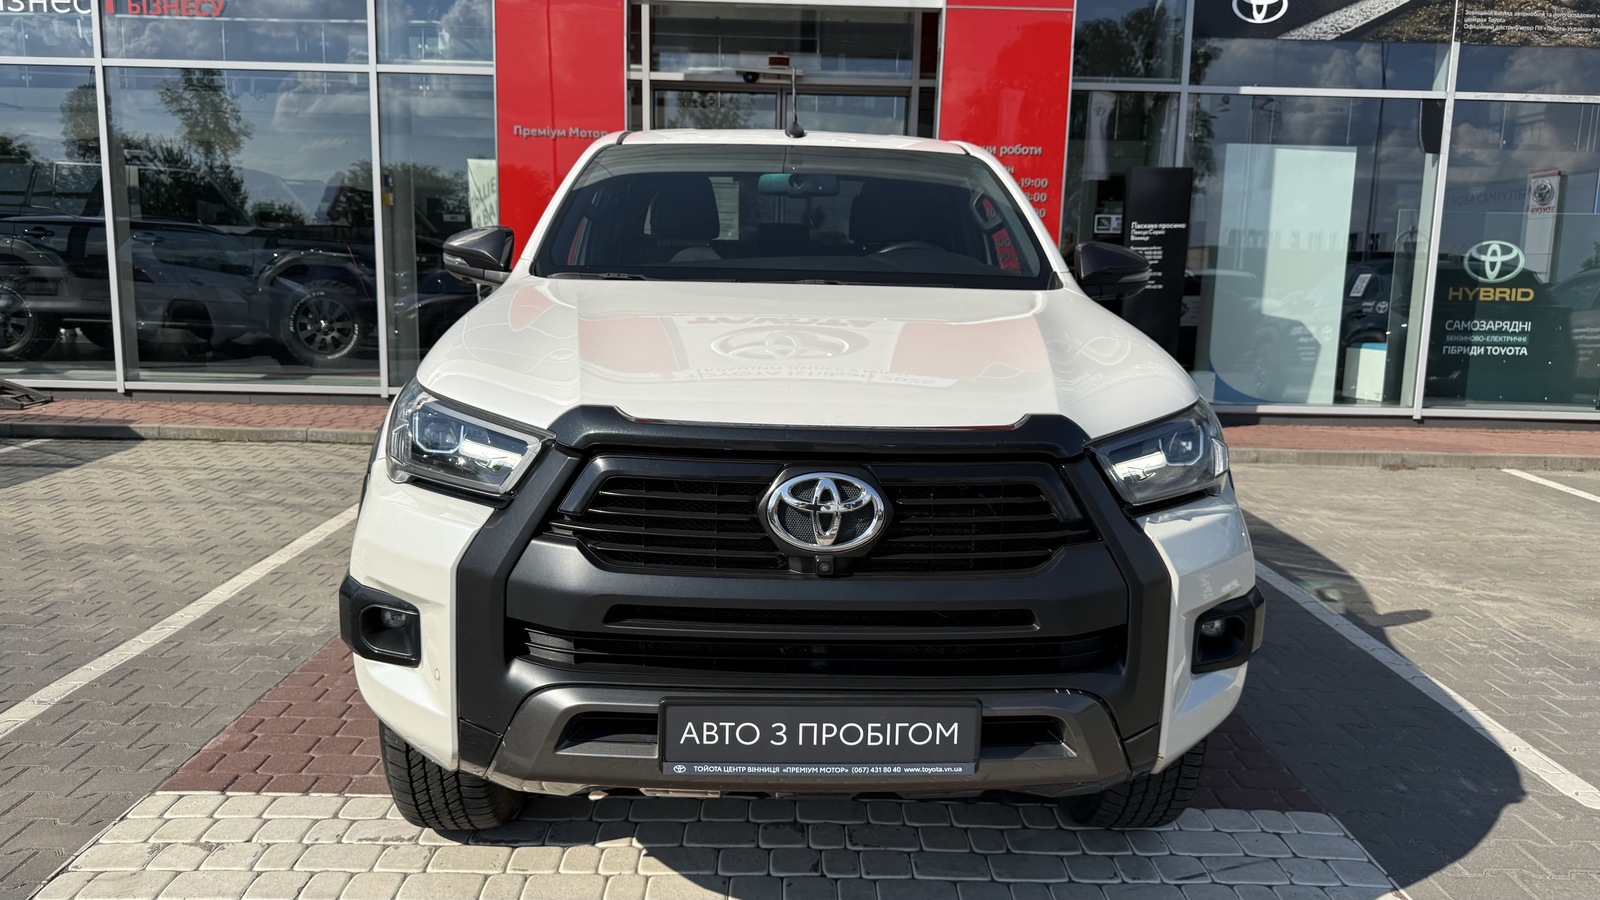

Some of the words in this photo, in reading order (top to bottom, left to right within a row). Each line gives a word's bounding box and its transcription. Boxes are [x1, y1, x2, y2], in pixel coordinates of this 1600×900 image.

[514, 125, 565, 138] Преміум
[569, 127, 608, 138] Мотор
[1000, 144, 1042, 157] роботи
[1448, 287, 1535, 301] HYBRID
[1445, 320, 1531, 332] САМОЗАРЯДНІ
[1442, 346, 1484, 356] ГІБРИДИ
[1486, 346, 1528, 355] TOYOTA
[680, 722, 760, 745] АВТО
[770, 723, 787, 745] З
[799, 722, 958, 745] ПРОБІГОМ
[723, 766, 746, 774] ЦЕНТР
[747, 766, 780, 774] ВІННИЦЯ
[783, 766, 818, 774] «ПРЕМІУМ
[851, 766, 869, 774] (067)
